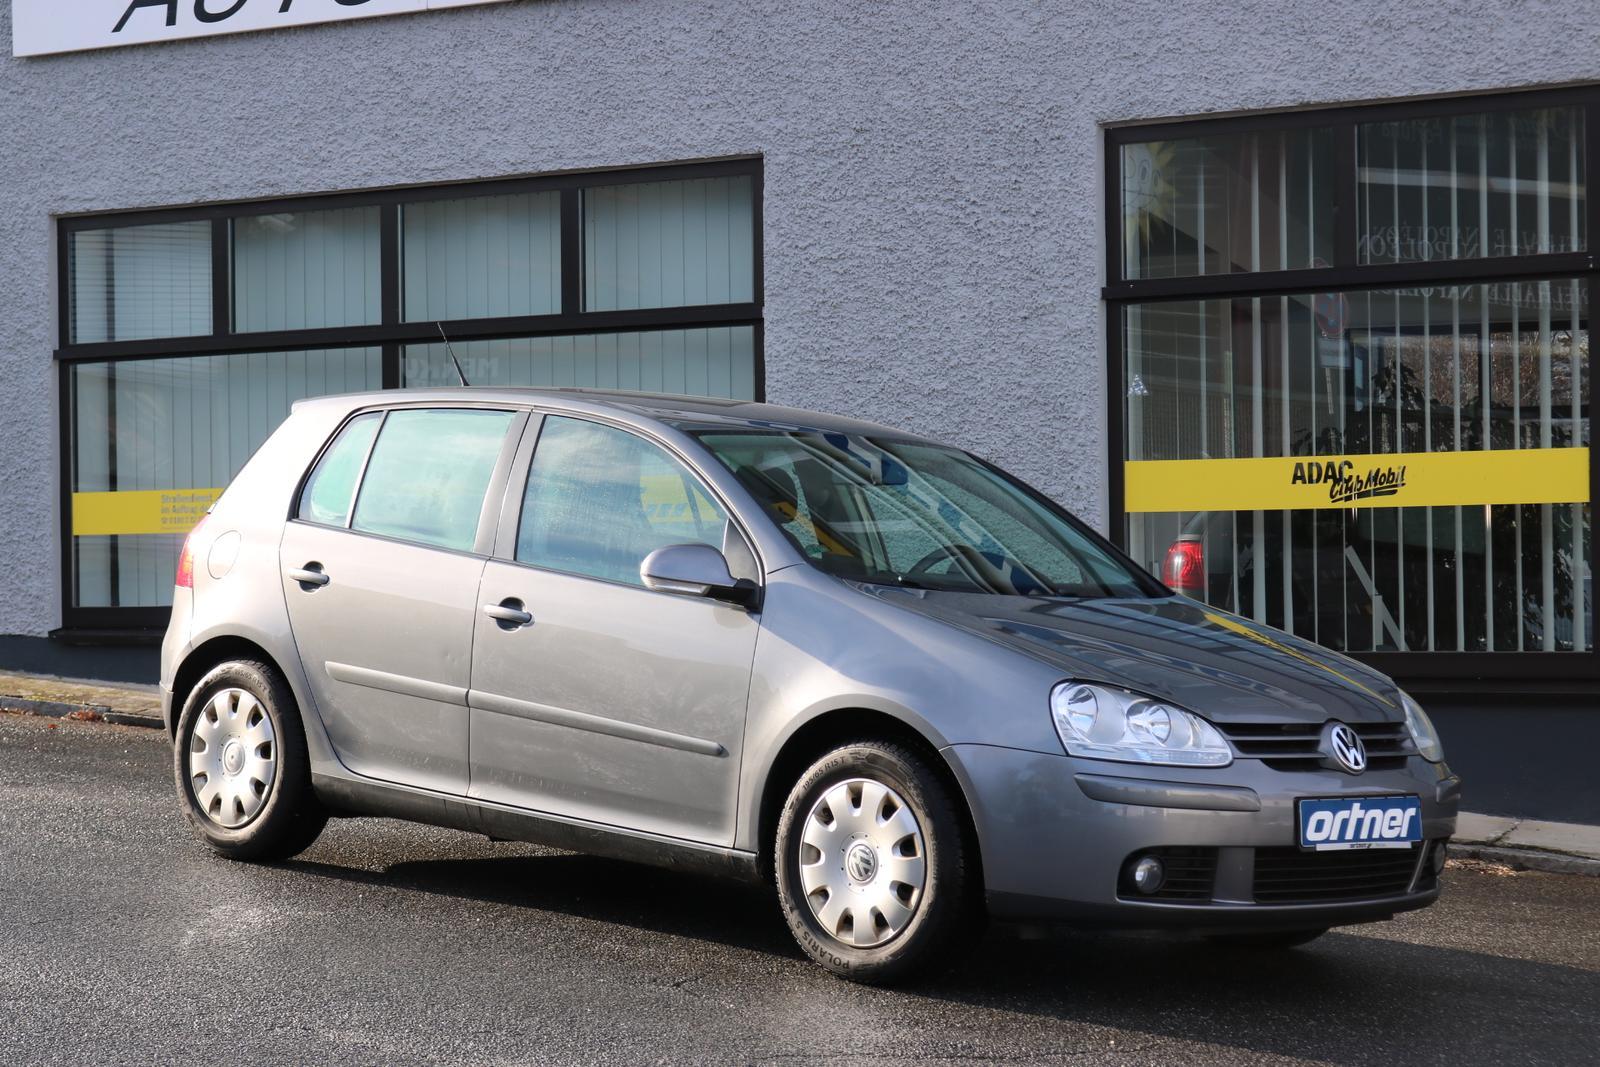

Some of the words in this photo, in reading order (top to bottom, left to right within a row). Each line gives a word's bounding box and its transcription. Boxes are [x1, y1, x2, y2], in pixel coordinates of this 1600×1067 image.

[1291, 460, 1353, 485] ADAC
[1306, 803, 1417, 841] ortner
[802, 931, 850, 969] POLARIS
